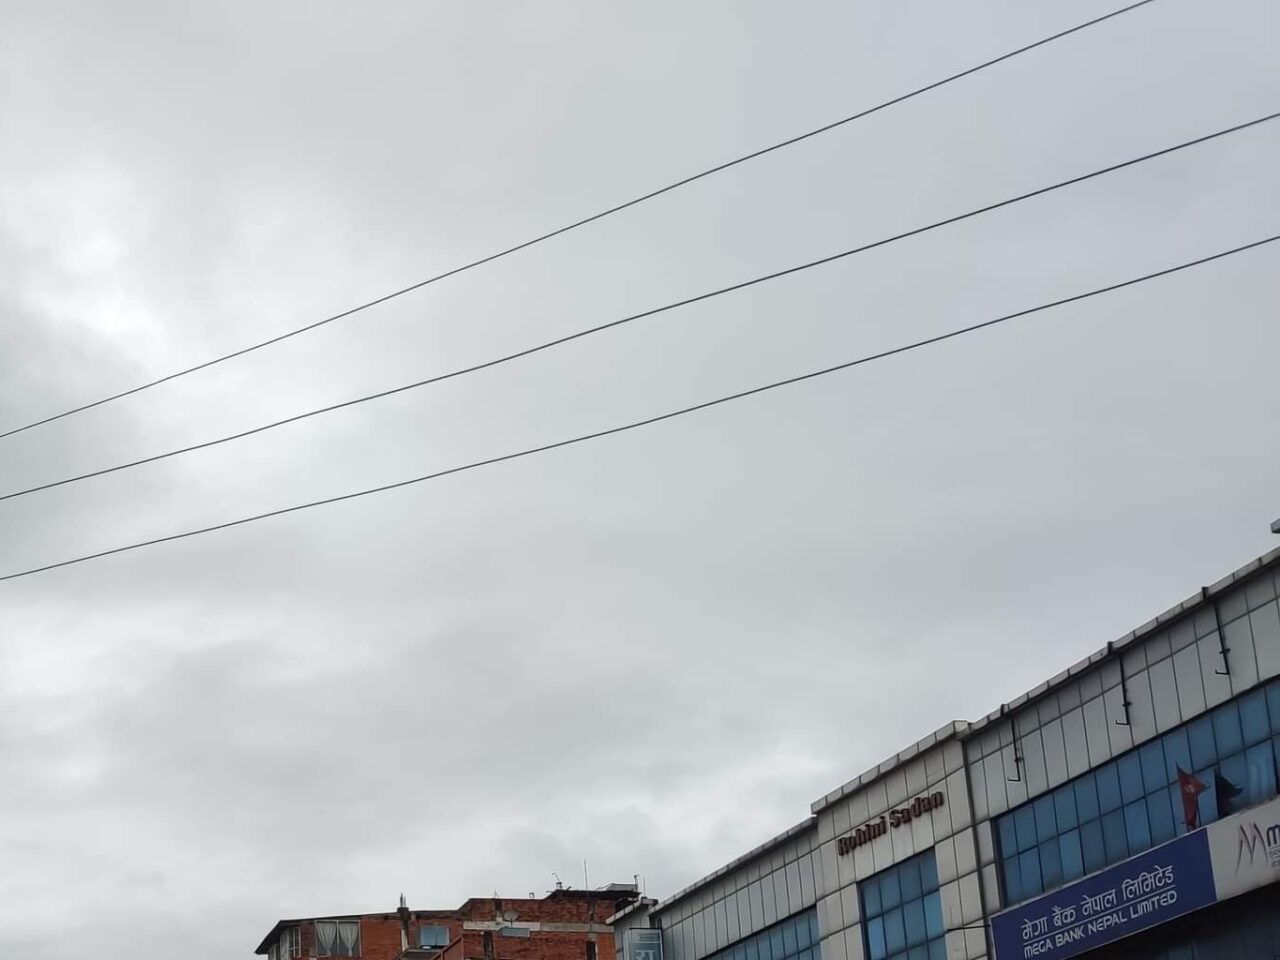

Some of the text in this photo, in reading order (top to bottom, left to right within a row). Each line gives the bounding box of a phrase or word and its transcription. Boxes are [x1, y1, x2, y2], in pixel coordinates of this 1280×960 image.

[889, 791, 944, 829] Sadan
[1020, 864, 1175, 940] मेगा बैंक नेपाल लिमिटेड
[1023, 889, 1178, 960] MEGA BANK NEPAL LIMITED
